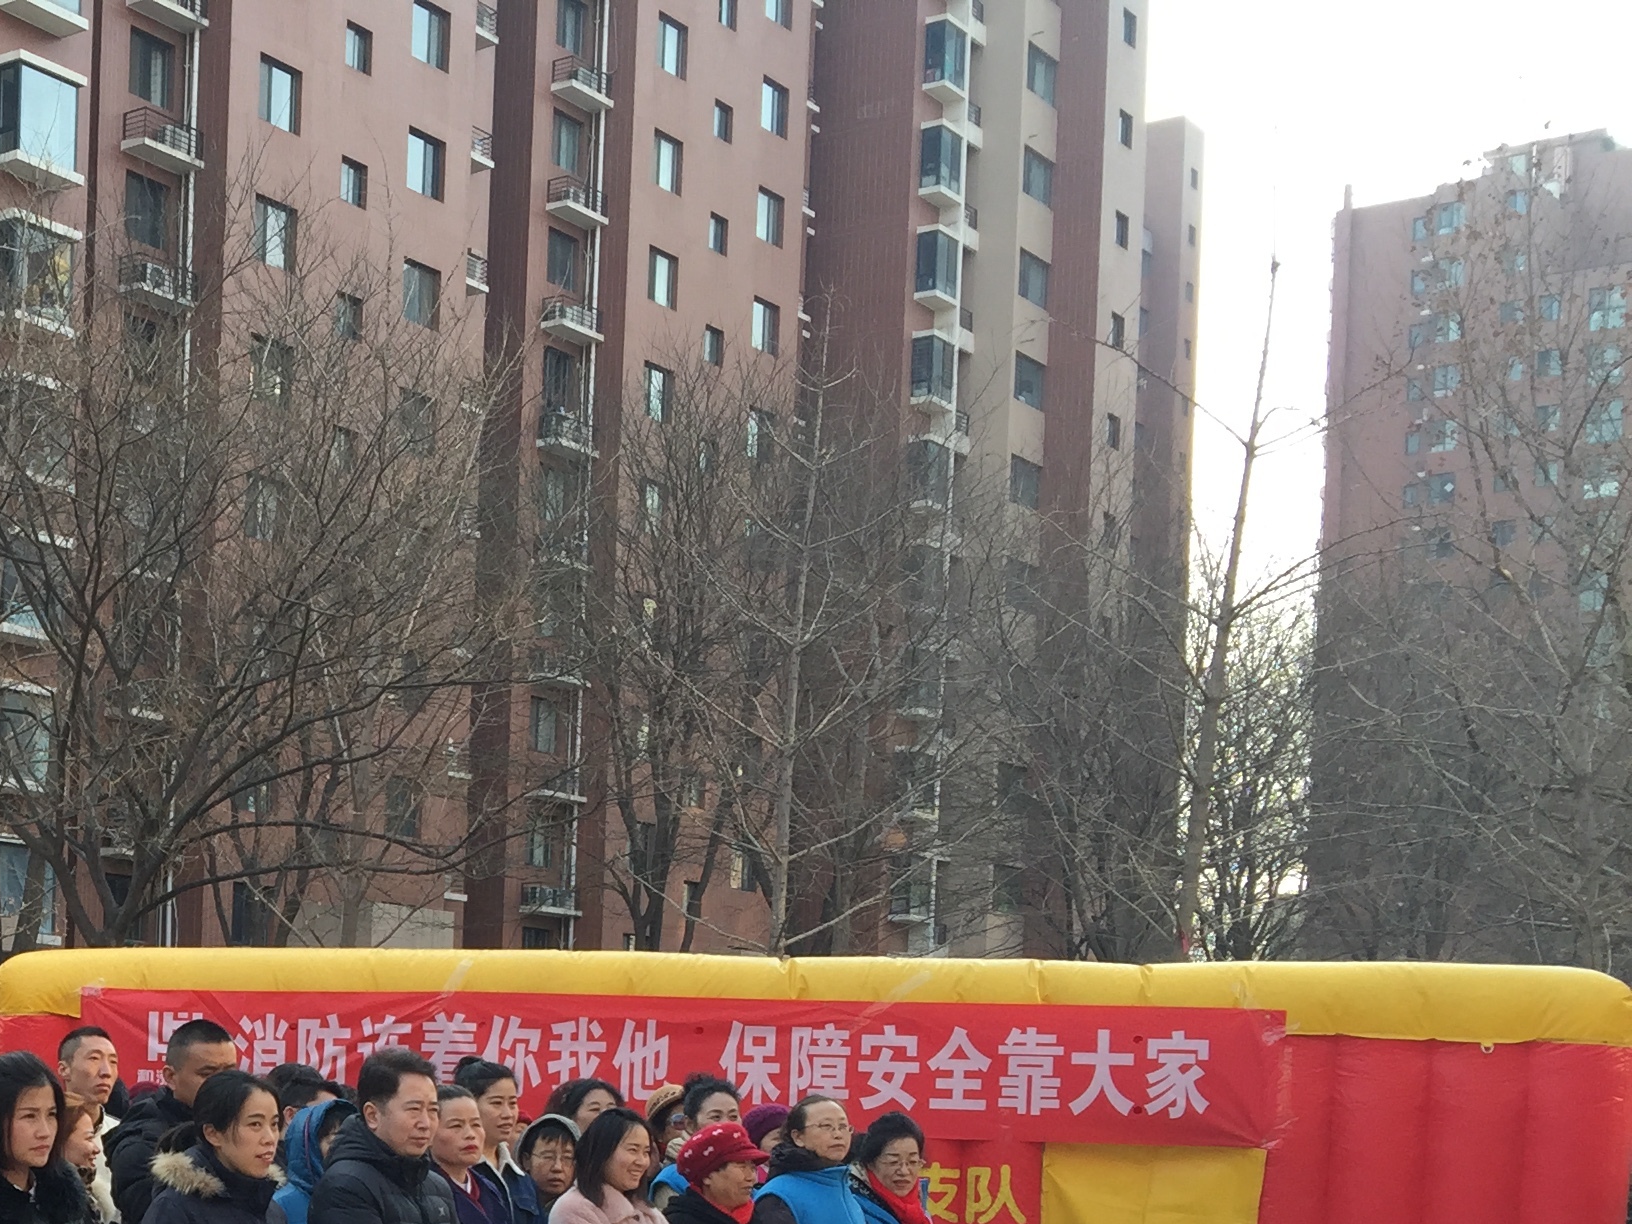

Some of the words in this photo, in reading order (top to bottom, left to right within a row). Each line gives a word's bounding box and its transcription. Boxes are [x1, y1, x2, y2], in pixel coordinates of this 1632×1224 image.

[719, 1019, 1211, 1120] 保障安全靠大家
[918, 1162, 1027, 1224] 支队
